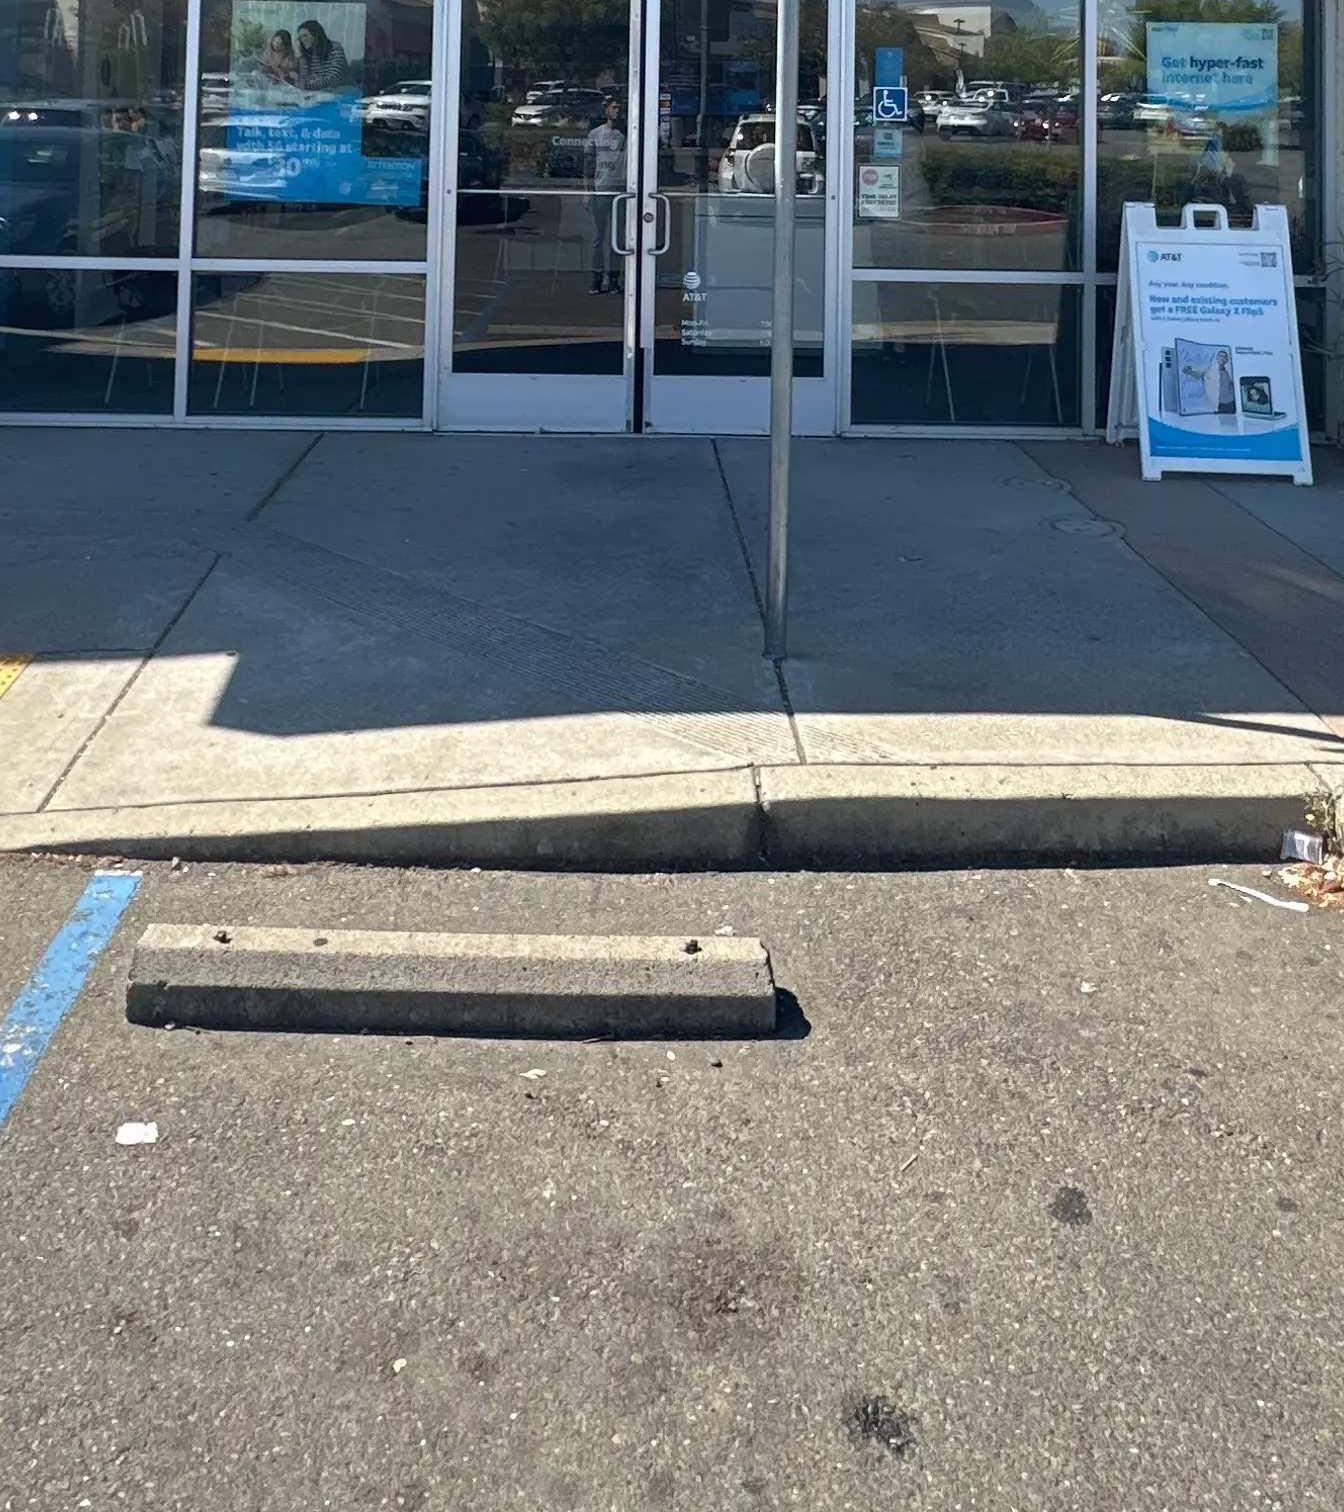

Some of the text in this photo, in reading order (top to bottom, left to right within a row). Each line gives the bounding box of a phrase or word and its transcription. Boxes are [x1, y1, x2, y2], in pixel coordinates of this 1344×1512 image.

[1161, 55, 1264, 72] Get hyper-fast
[1162, 71, 1253, 84] internet here
[339, 143, 353, 153] at
[551, 136, 618, 149] Connecting
[1160, 253, 1182, 261] AT&T
[682, 292, 708, 302] AT&T
[1171, 295, 1189, 304] and
[1191, 296, 1227, 306] existing
[1229, 297, 1278, 306] customers
[1175, 305, 1198, 315] FREE
[1200, 306, 1231, 317] Galaxy
